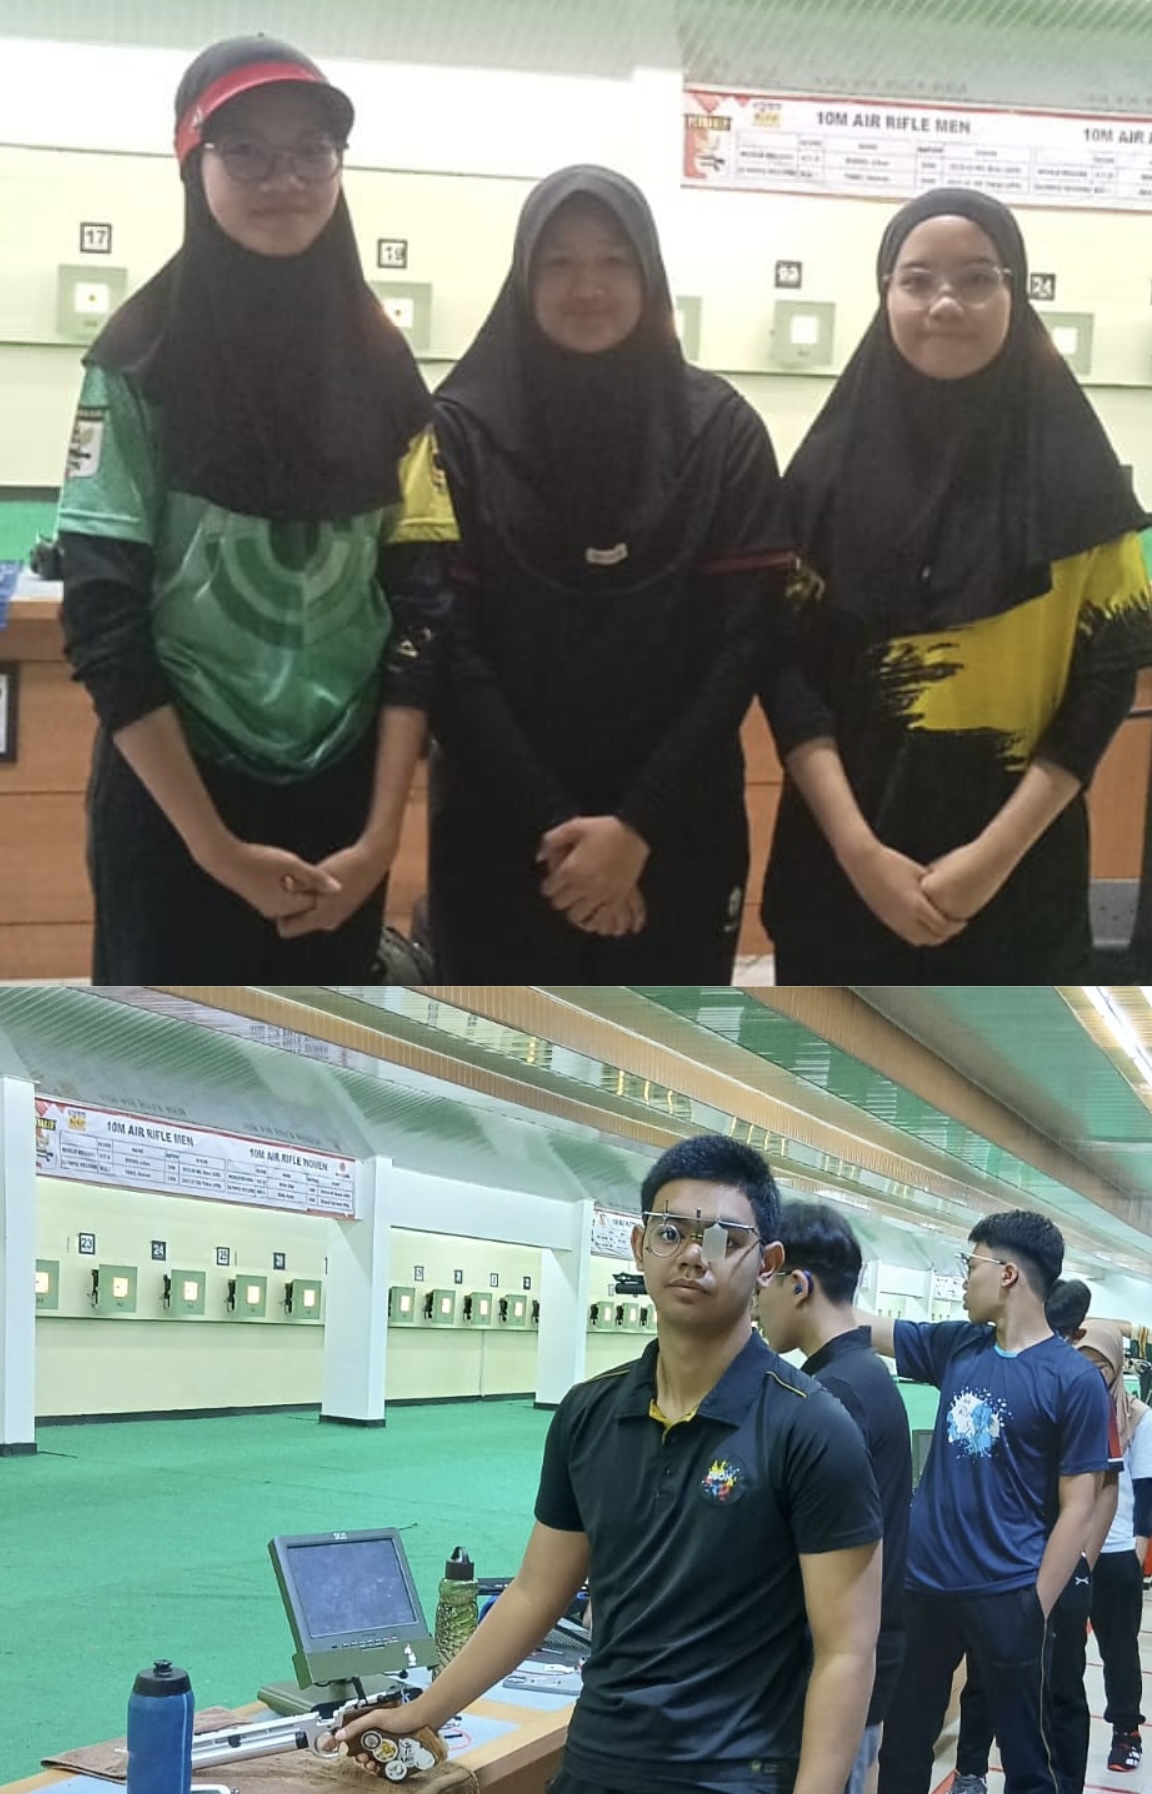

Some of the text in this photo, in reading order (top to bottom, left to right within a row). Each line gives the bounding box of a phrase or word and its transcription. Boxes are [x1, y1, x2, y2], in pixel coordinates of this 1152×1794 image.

[817, 111, 971, 134] 10M AIR RIFLE MEN
[1083, 127, 1114, 142] 10M
[1117, 129, 1145, 144] AIR
[86, 229, 107, 244] 17
[1032, 277, 1051, 297] 24
[107, 1121, 194, 1147] 10M AIR RIFLE MEN
[249, 1148, 328, 1171] 10M AIR RIFLE WOMEN
[81, 1237, 93, 1249] 23
[153, 1243, 164, 1256] 24
